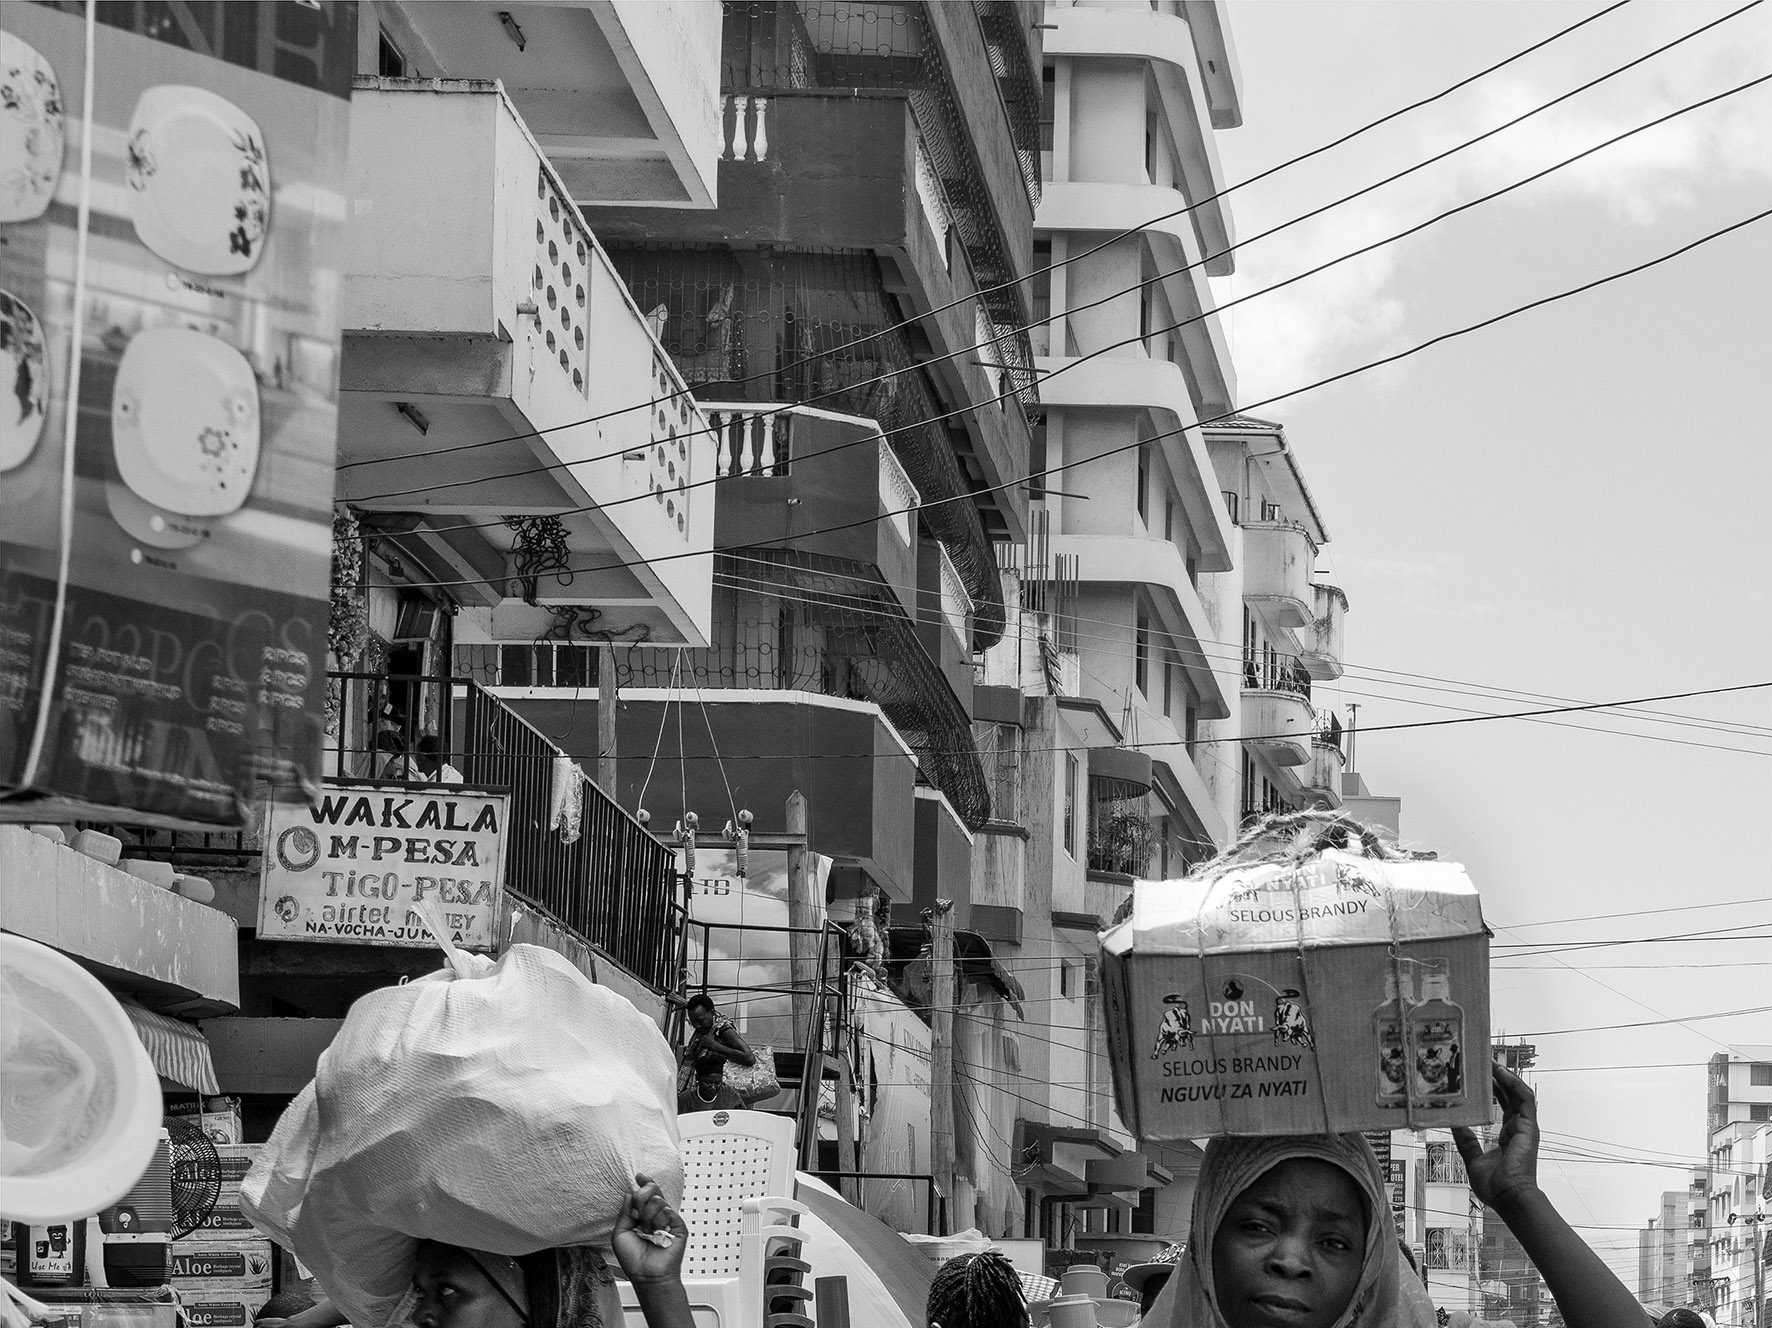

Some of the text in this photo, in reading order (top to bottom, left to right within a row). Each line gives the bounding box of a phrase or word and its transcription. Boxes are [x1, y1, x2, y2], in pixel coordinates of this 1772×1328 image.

[310, 795, 498, 834] WAKALA
[328, 835, 479, 867] M-PESA
[322, 903, 390, 924] airtel
[1230, 900, 1368, 923] SELOUS BRANDY
[305, 922, 464, 943] NA-VOCHA-JUMA
[1209, 1000, 1254, 1018] DON
[1201, 1018, 1264, 1033] NYATI
[1163, 1055, 1302, 1078] SELOUS BRANDY
[1160, 1080, 1307, 1104] NGUVU ZA NYATI
[1390, 1174, 1404, 1182] OTEL
[203, 1216, 222, 1227] oe
[31, 1261, 60, 1270] Use Me
[172, 1258, 212, 1274] Aloe
[186, 1308, 212, 1324] loe
